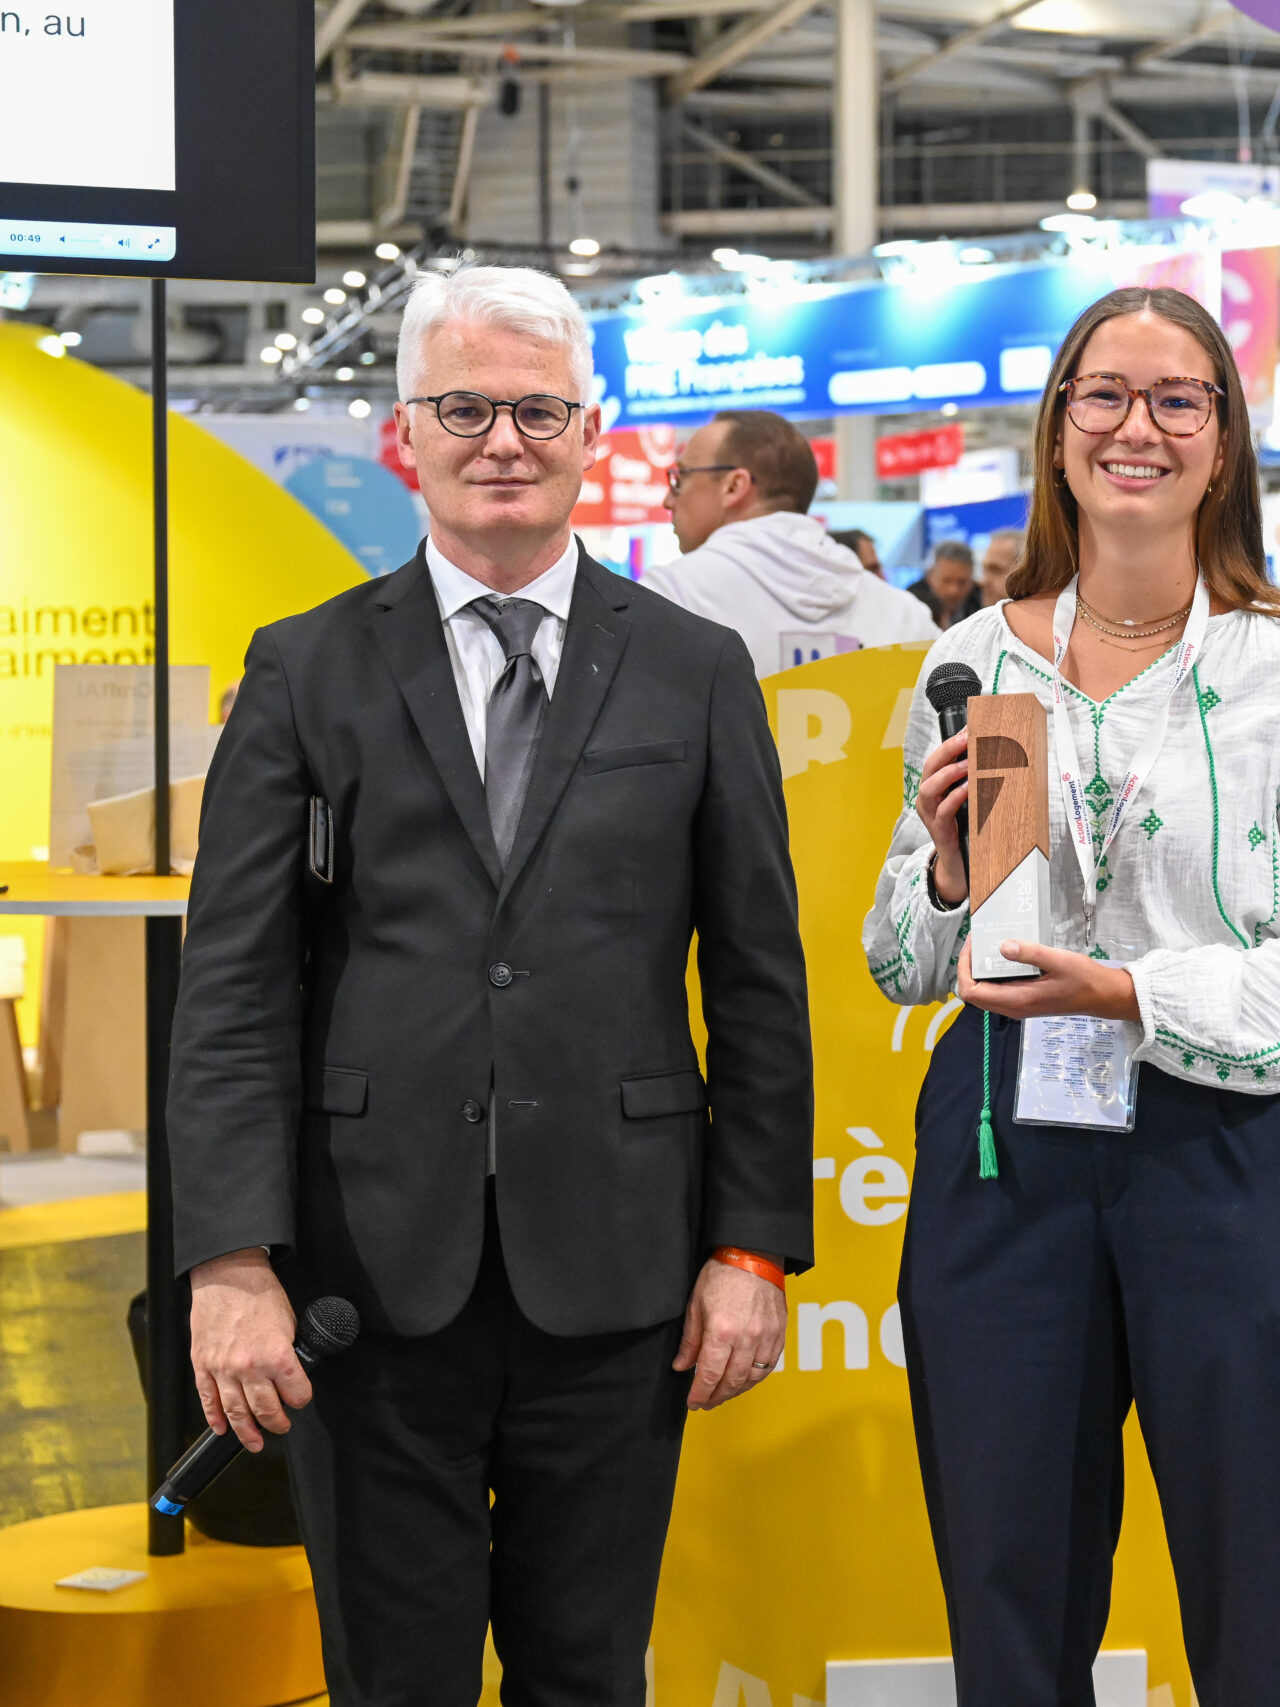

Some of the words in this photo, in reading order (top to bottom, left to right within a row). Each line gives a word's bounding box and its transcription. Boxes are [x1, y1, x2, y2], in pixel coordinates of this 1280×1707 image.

[43, 14, 86, 37] au
[10, 233, 41, 243] 00:49
[1017, 879, 1032, 895] 20
[1017, 896, 1032, 912] 25
